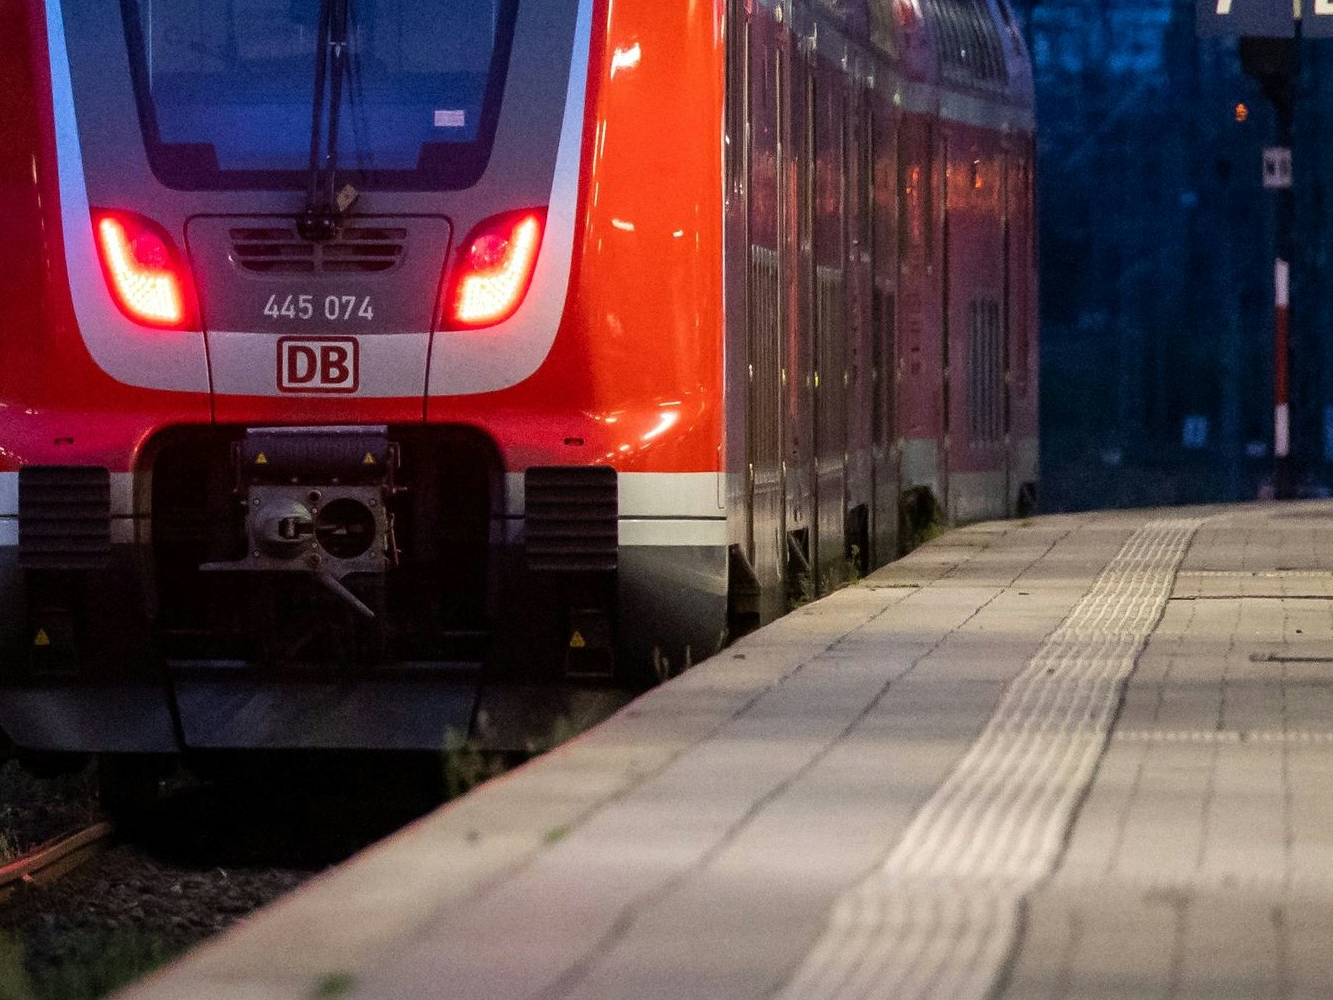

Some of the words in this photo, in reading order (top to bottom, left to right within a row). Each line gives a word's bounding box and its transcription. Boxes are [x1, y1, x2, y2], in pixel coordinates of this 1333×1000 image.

[263, 294, 314, 320] 445
[324, 295, 374, 321] 074
[287, 345, 350, 384] DB
